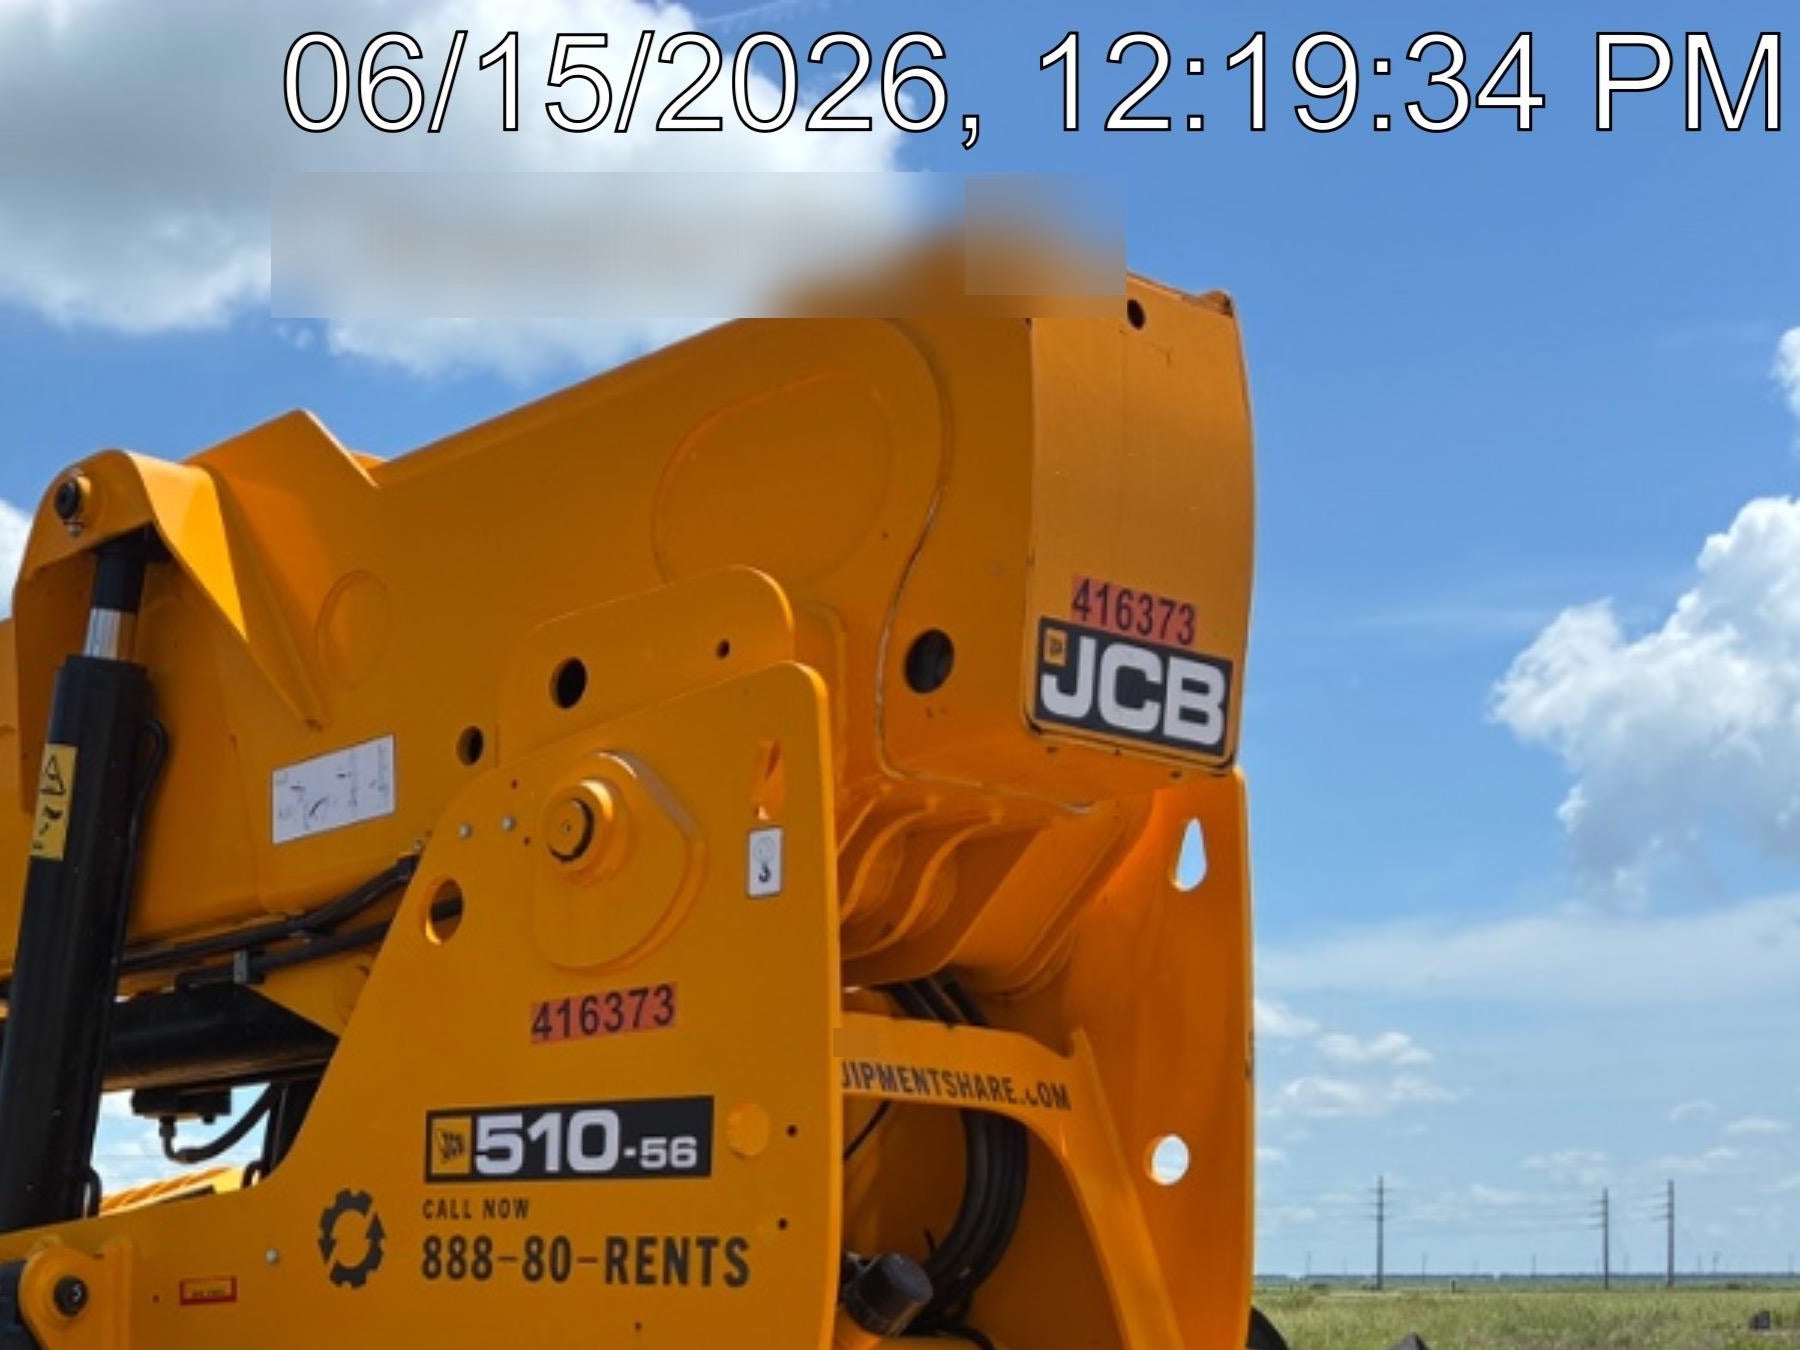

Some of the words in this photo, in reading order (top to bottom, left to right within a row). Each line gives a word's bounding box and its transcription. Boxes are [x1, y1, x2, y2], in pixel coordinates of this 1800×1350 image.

[1071, 577, 1197, 646] 416373
[1040, 635, 1226, 746] JCB
[531, 984, 675, 1040] 416373
[475, 1108, 698, 1175] 510-56
[422, 1199, 473, 1219] CALL
[483, 1198, 530, 1219] NOW
[422, 1234, 750, 1287] 888-80-RENTS
